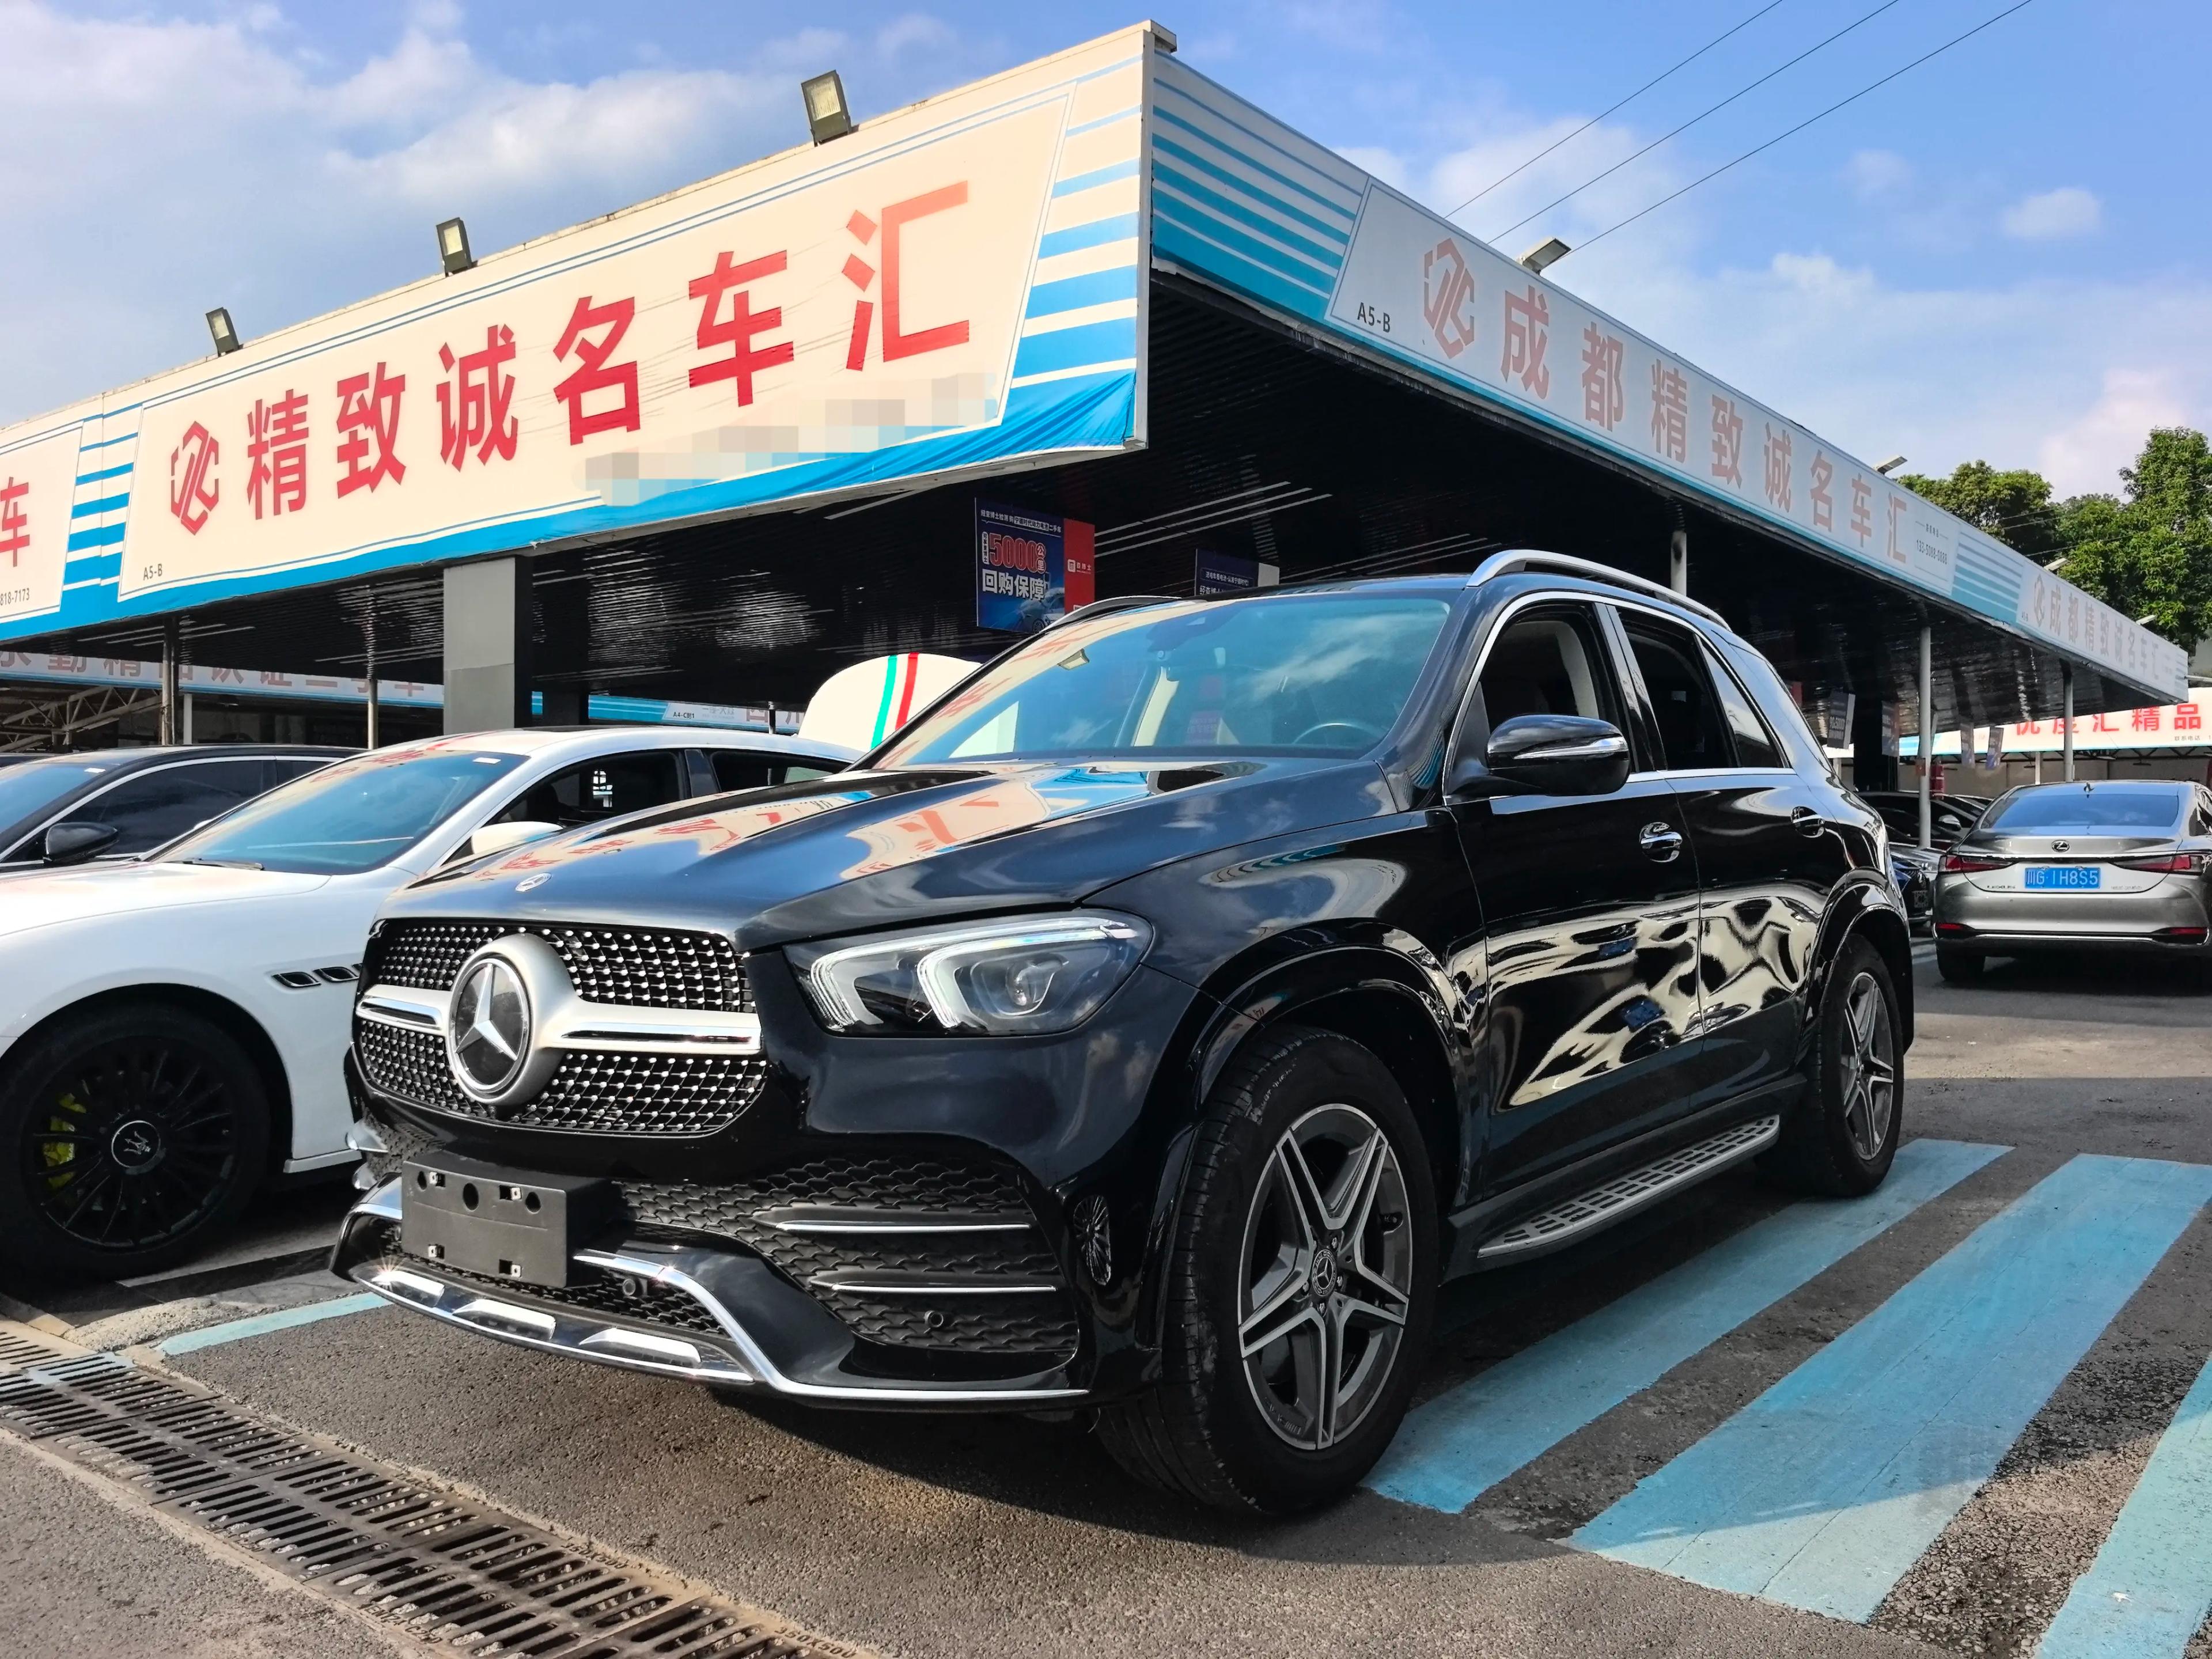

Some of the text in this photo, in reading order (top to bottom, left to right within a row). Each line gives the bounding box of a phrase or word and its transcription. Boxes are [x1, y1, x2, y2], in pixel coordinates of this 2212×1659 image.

[1357, 301, 1391, 334] A5-B
[247, 181, 970, 520] 精致诚名车汇
[1501, 285, 1907, 564] 成都精致诚名车汇
[0, 476, 31, 567] 车
[989, 532, 1039, 573] 5000
[143, 563, 163, 581] A5-B
[982, 569, 1045, 601] 回购保障
[0, 588, 30, 605] 818-7173
